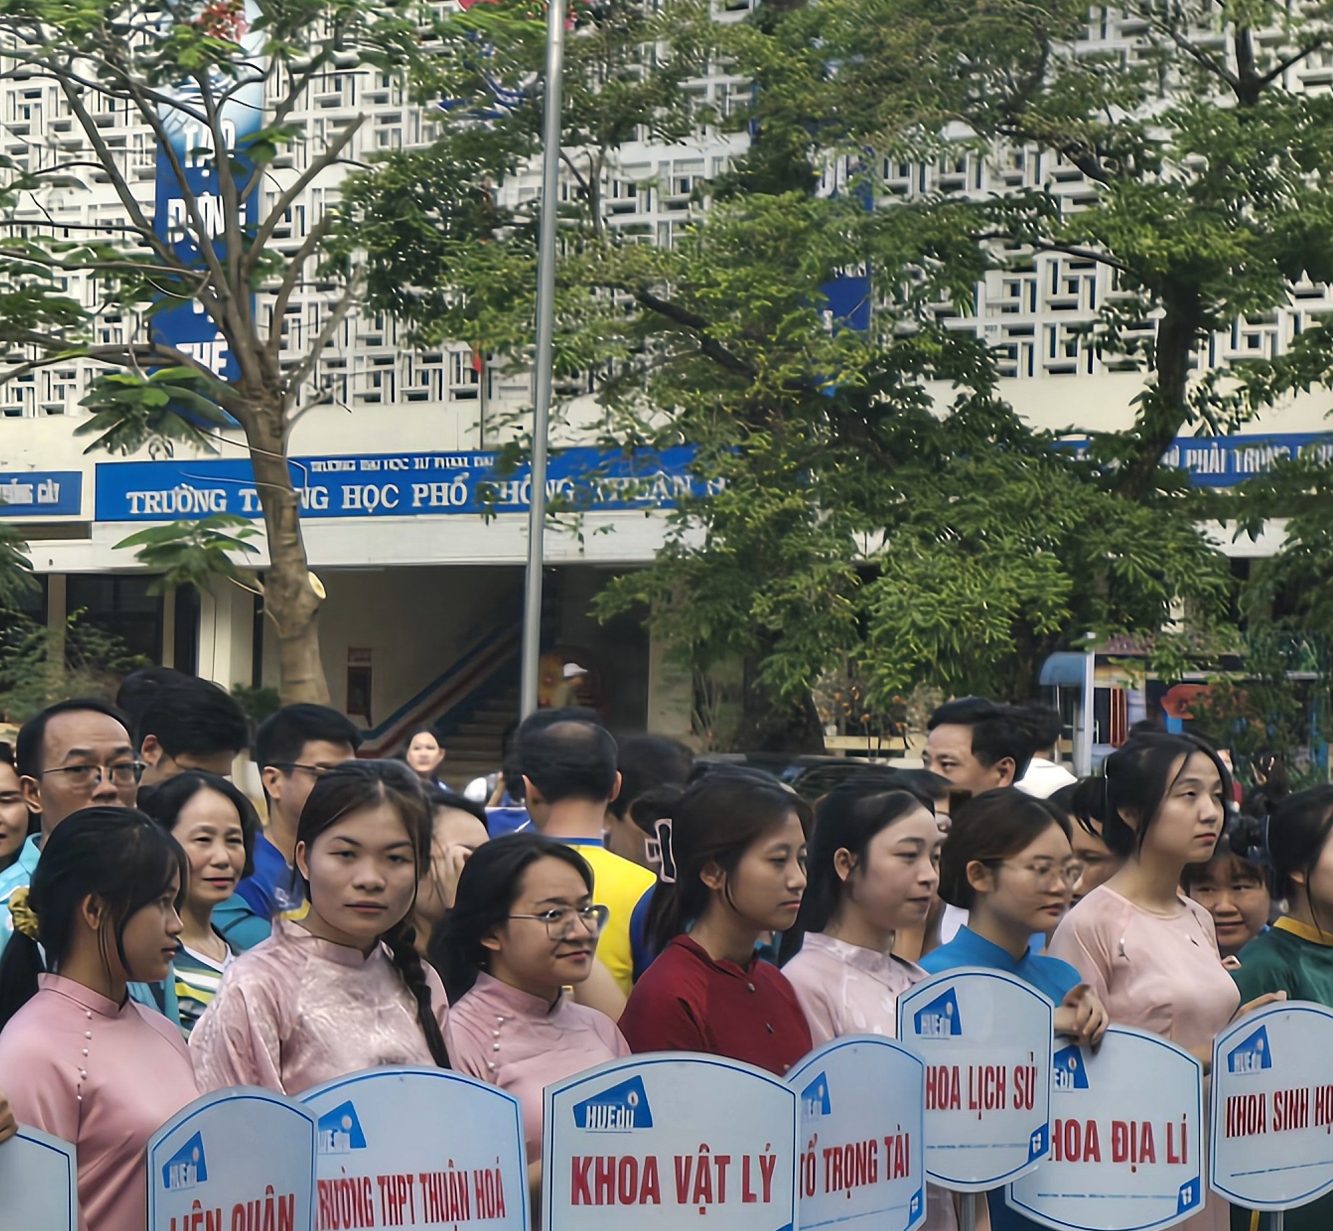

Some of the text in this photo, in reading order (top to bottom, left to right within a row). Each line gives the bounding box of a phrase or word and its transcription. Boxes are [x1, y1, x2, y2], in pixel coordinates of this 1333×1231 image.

[126, 483, 228, 515] TRƯỜNG
[238, 485, 330, 514] TNG
[341, 483, 400, 514] HỌC
[411, 472, 470, 507] PHỔ
[925, 1065, 961, 1110] HOA
[968, 1065, 1006, 1121] LỊCH
[1226, 1084, 1333, 1138] KHOA SINH HỌ
[822, 1138, 878, 1200] TRỌNG
[883, 1123, 910, 1181] TÀI
[1049, 1112, 1188, 1174] HOA ĐỊA LÍ
[315, 1165, 375, 1231] RƯỜNG
[376, 1173, 416, 1227] THPT
[570, 1155, 661, 1206] KHOA
[674, 1143, 731, 1216] VẬT
[741, 1143, 777, 1204] LÝ
